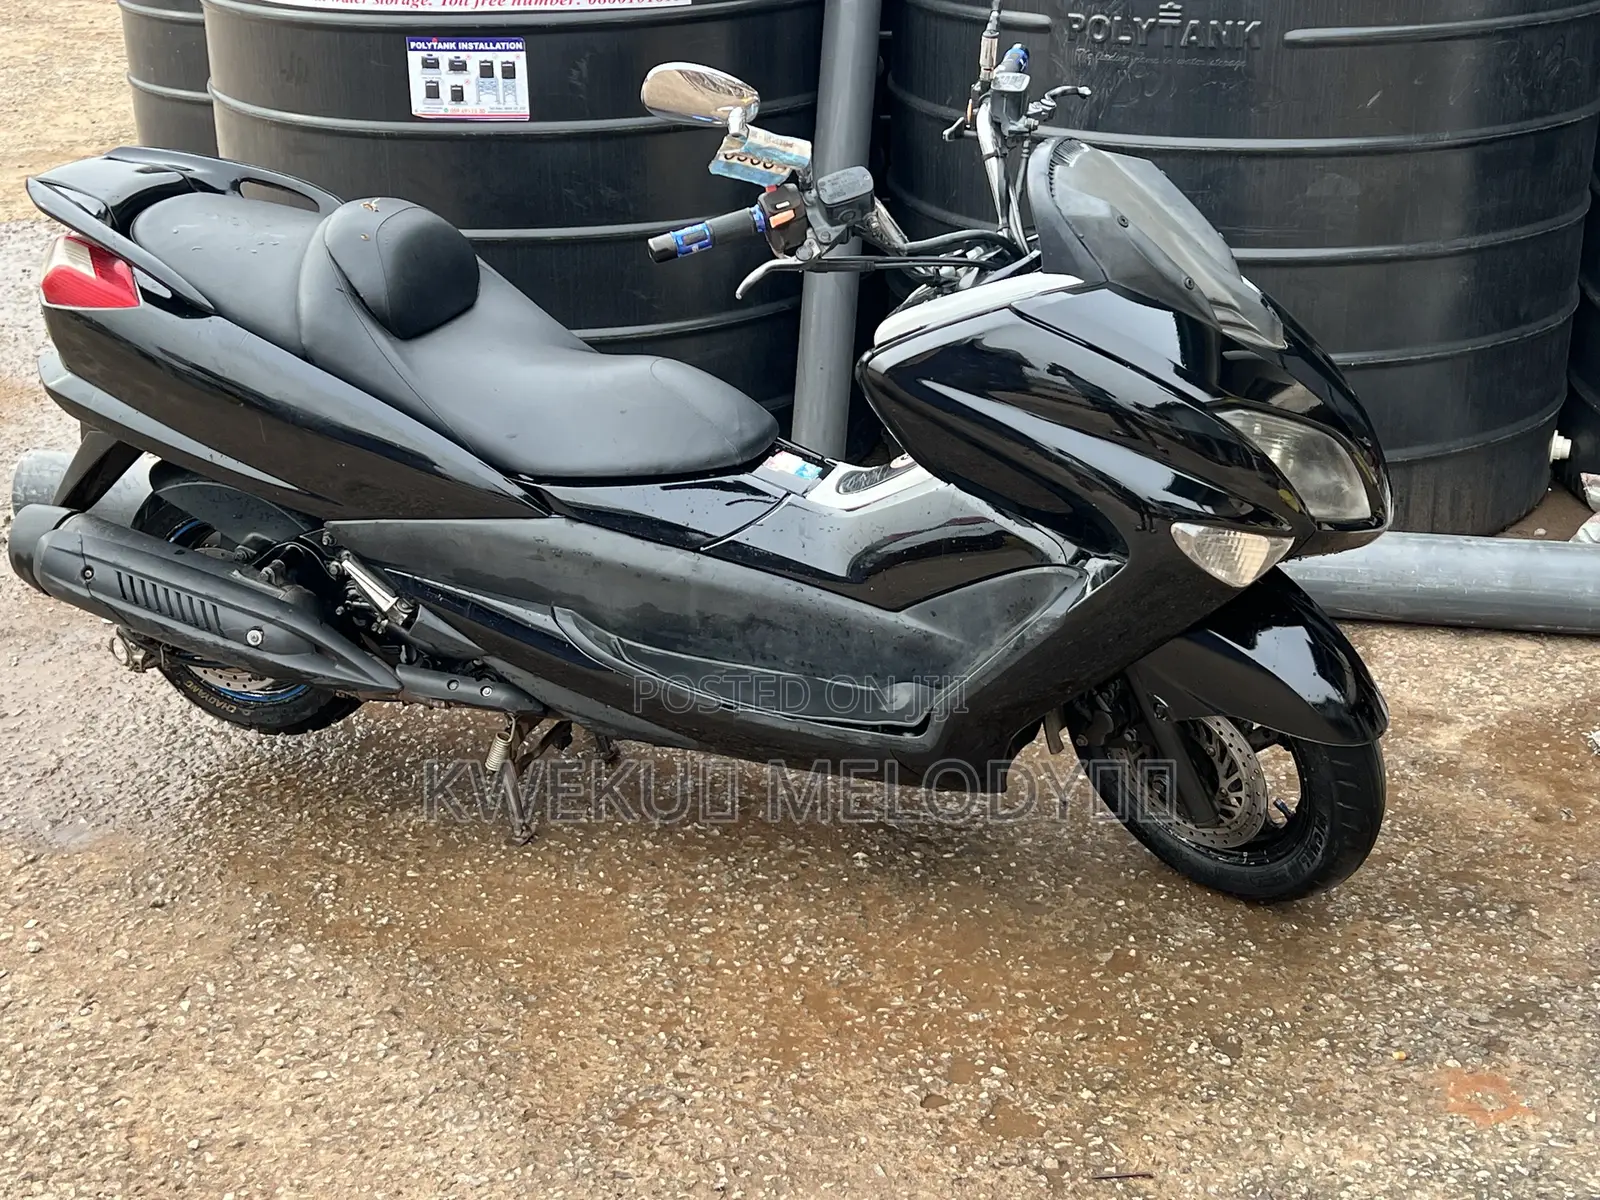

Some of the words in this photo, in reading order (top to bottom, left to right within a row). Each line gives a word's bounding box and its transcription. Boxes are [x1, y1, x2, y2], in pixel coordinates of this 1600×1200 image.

[1065, 13, 1262, 49] POLYTANK
[410, 41, 457, 50] POLYTANK
[458, 41, 523, 50] INSTALLATION
